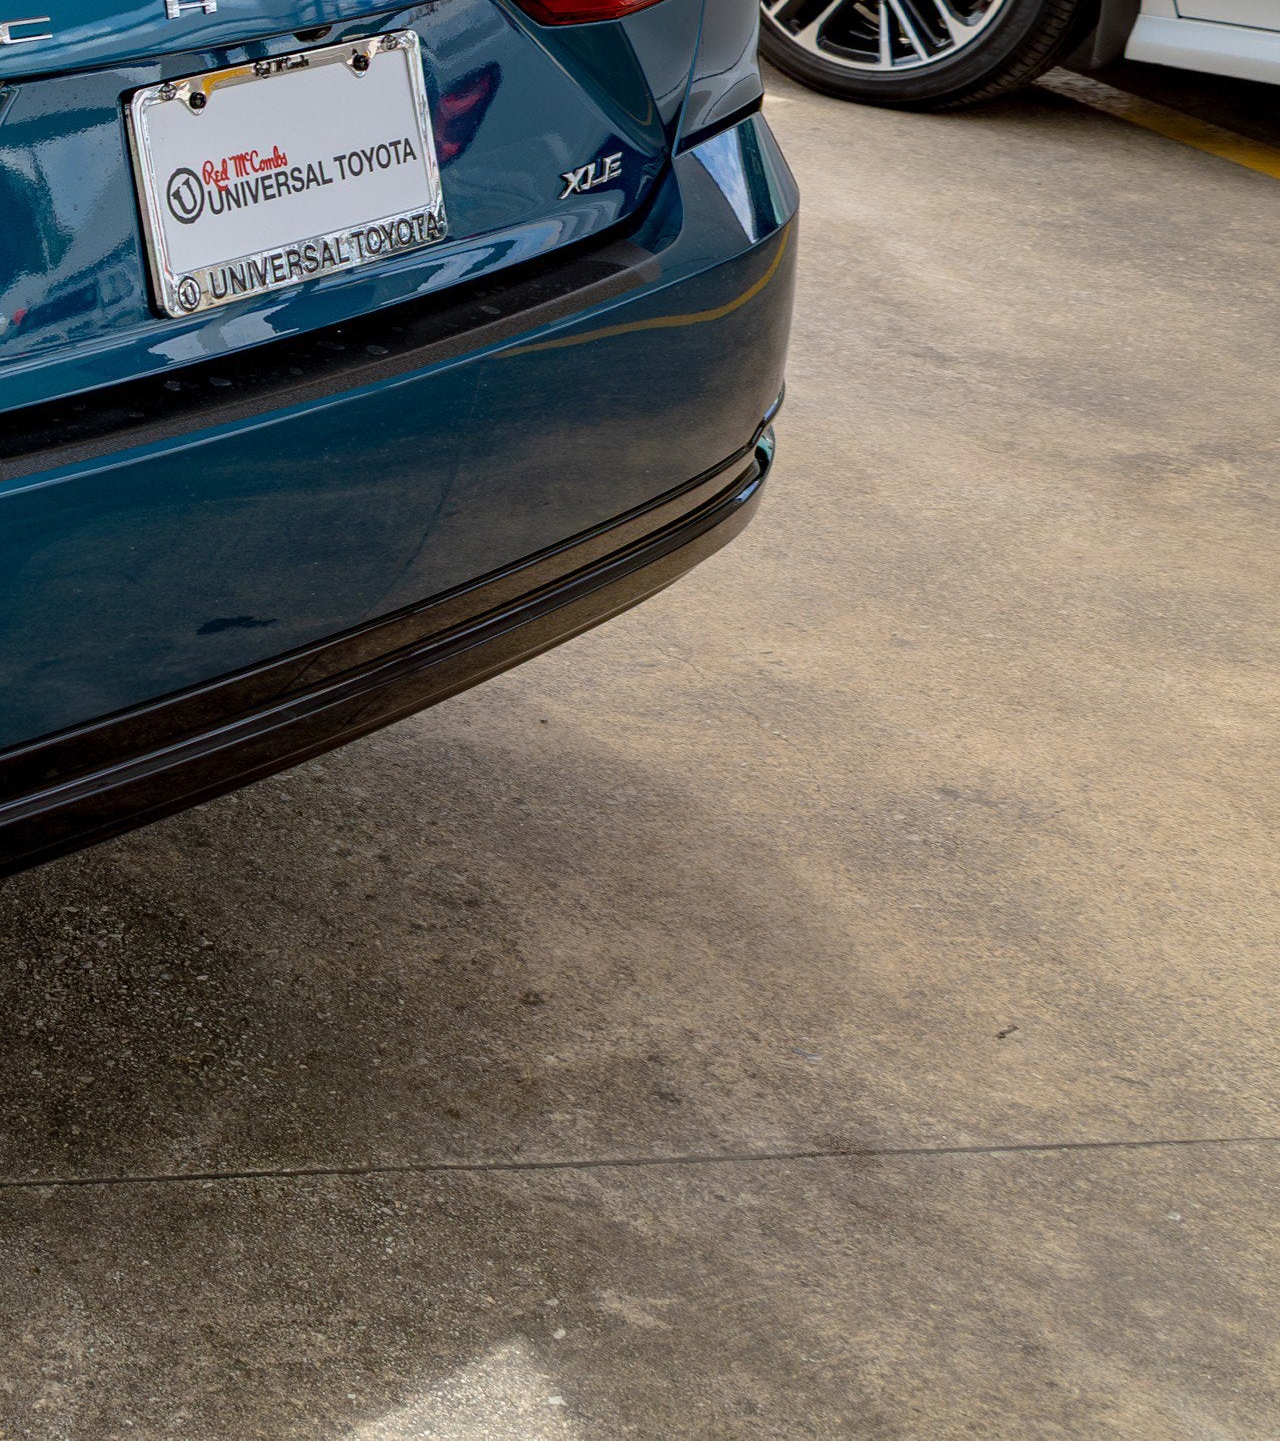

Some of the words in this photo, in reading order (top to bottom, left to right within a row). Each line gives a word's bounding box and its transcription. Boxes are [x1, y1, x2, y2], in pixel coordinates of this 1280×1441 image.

[202, 159, 229, 191] Red
[206, 160, 333, 215] UNIVERSAL
[333, 137, 417, 180] TOYOTA
[559, 151, 623, 199] XLE
[207, 236, 350, 299] UNIVERSAL
[351, 210, 440, 258] TOYOTA
